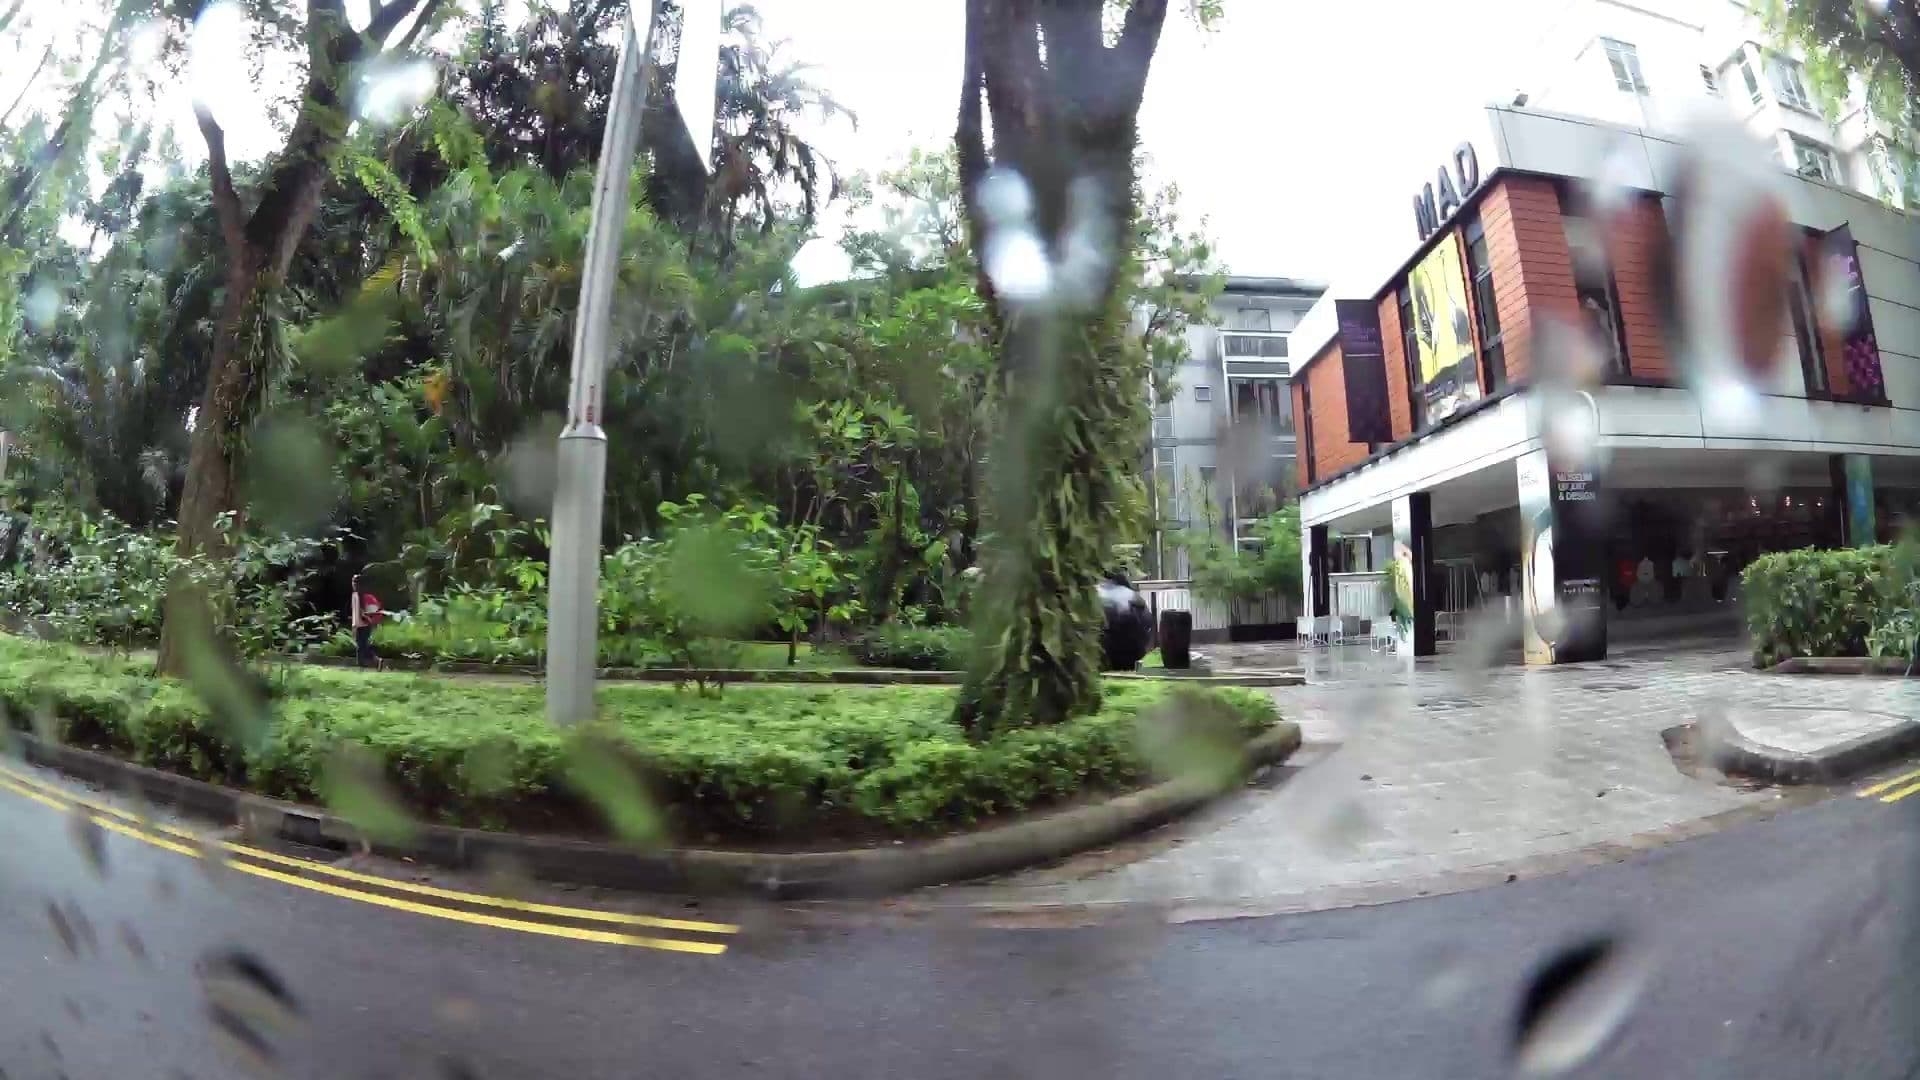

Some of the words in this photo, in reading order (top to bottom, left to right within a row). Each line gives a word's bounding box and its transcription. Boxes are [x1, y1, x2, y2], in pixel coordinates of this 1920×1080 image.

[1413, 141, 1479, 241] MAD
[1557, 471, 1593, 481] MUSEUM
[1566, 491, 1596, 502] DESIGN
